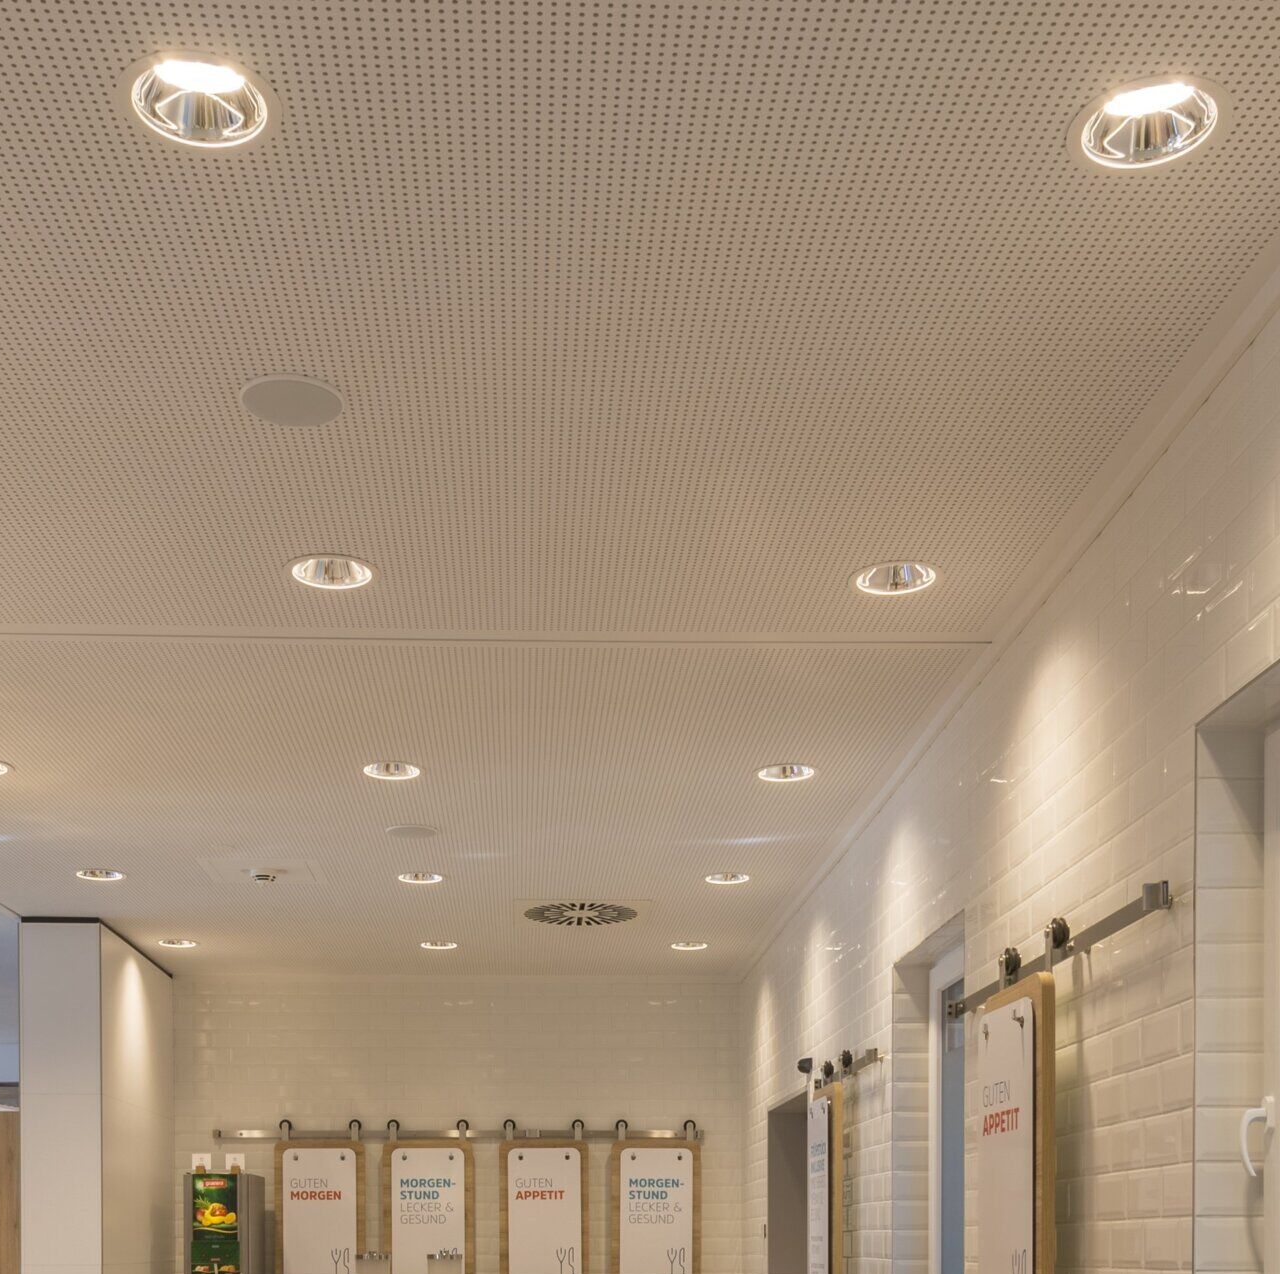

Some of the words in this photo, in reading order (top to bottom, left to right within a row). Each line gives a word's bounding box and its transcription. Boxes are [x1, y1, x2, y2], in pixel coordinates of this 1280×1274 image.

[982, 1079, 1011, 1108] GUTEN
[982, 1107, 1020, 1137] APPETIT
[290, 1177, 328, 1189] GUTEN
[399, 1178, 457, 1189] MORGEN-
[515, 1177, 553, 1189] GUTEN
[627, 1178, 685, 1189] MORGEN-
[290, 1190, 342, 1201] MORGEN
[399, 1190, 440, 1201] STUND
[515, 1190, 565, 1201] APPETIT
[627, 1190, 668, 1201] STUND
[399, 1202, 442, 1213] LECKER
[445, 1202, 454, 1213] &
[627, 1202, 670, 1213] LECKER
[673, 1202, 682, 1213] &
[399, 1213, 447, 1225] GESUND
[627, 1213, 675, 1225] GESUND
